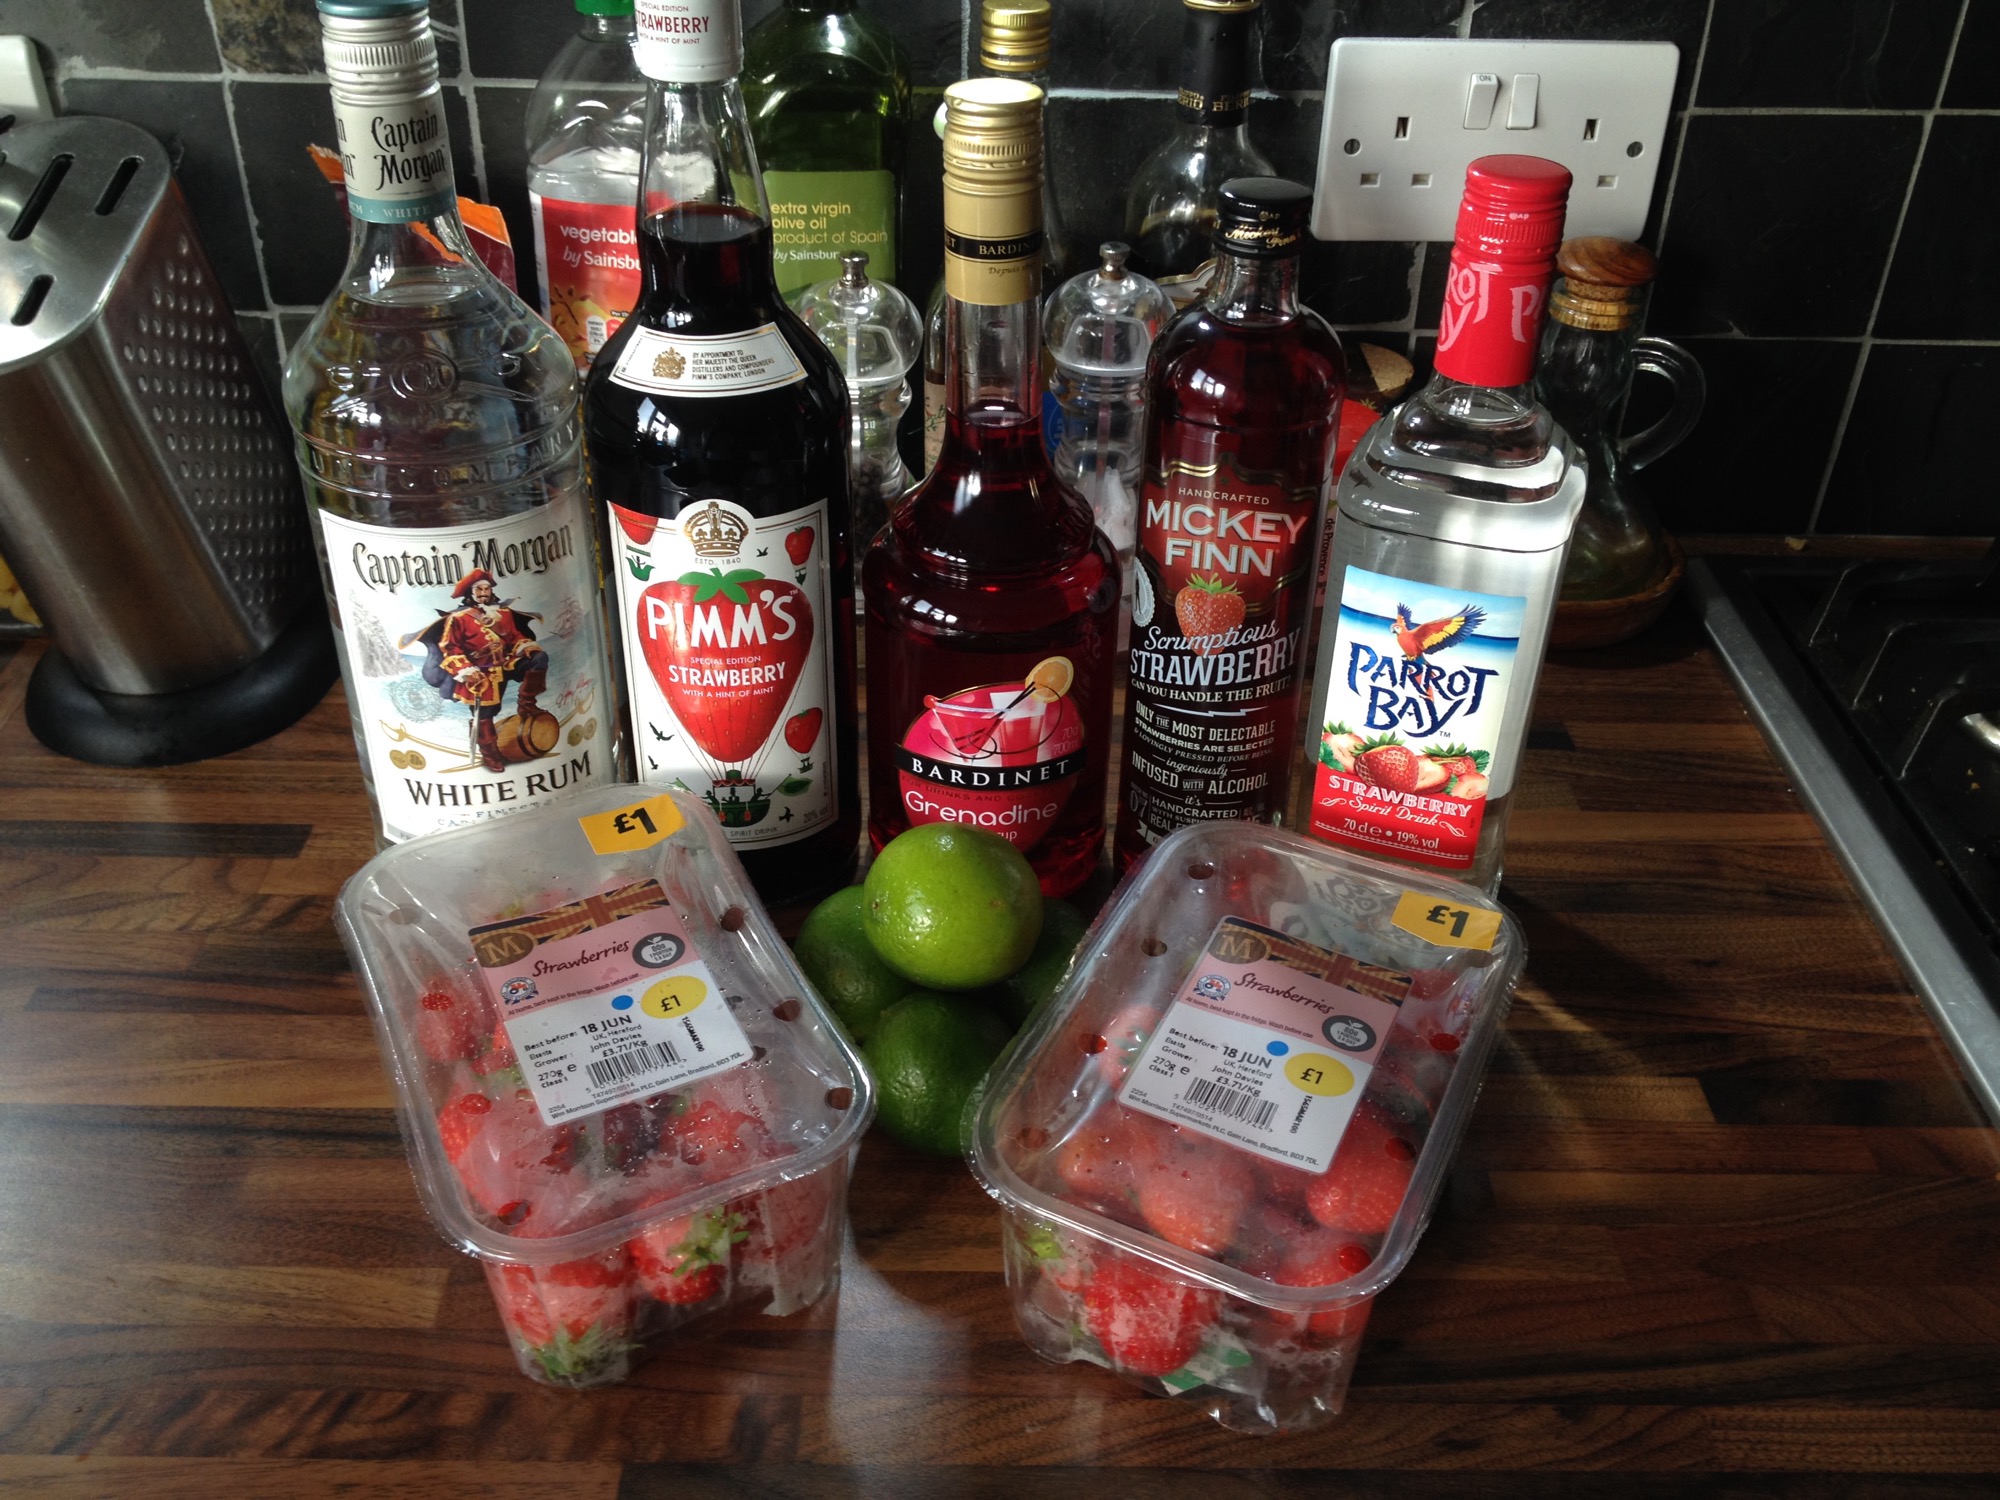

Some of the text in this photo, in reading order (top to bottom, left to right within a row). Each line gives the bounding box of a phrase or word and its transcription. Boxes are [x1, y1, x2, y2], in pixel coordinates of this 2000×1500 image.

[636, 10, 709, 33] TRAWBERRY
[661, 5, 689, 13] EDITION
[371, 110, 439, 153] Captain
[373, 147, 446, 191] Morgan
[383, 204, 432, 218] WHITE
[771, 202, 851, 217] extra virgin
[772, 217, 827, 229] olive oil
[774, 231, 888, 244] product of Spain
[563, 246, 642, 272] by Sainsbu
[774, 248, 788, 264] by
[692, 365, 723, 373] DISTILLERS
[737, 358, 775, 371] COMPOUNDERS
[740, 355, 757, 363] QUEEN
[744, 368, 766, 377] LONDON
[1178, 487, 1270, 505] HANDCRAFTED
[1146, 498, 1308, 545] MICKEY
[1325, 517, 1335, 531] de
[352, 522, 575, 593] Captain Morgan
[721, 557, 742, 565] 1840
[1165, 537, 1275, 578] FINN
[1319, 531, 1334, 577] Provence
[645, 589, 797, 650] PIMM'S
[1144, 619, 1281, 660] Scrumptious
[690, 655, 761, 665] SPECIAL EDITION
[1130, 627, 1302, 687] STRAWBERRY
[668, 661, 786, 687] STRAWBERRY
[1347, 641, 1500, 717] PARROT
[682, 686, 774, 698] WITH A HINT OF MINT
[1131, 678, 1146, 691] CAN
[1146, 684, 1168, 698] YOU
[1169, 689, 1223, 702] HANDLE
[1226, 688, 1254, 702] THE
[1135, 699, 1276, 742] ONLY THE MOST DELECTABLE
[1363, 684, 1467, 738] BAY
[1134, 716, 1276, 753] STRAWBERRIES ARE SELECTED
[1139, 731, 1174, 754] LOVINGLY
[1174, 749, 1216, 763] PRESSED
[1217, 752, 1251, 763] BEFORE
[404, 749, 593, 807] WHITE RUM
[911, 756, 1070, 787] BARDINET
[1132, 749, 1180, 789] INFUSED
[1182, 779, 1204, 791] WITH
[1206, 771, 1270, 796] ALCOHOL
[1165, 756, 1230, 780] ingeniously
[905, 789, 1059, 827] Grenadine
[1151, 796, 1239, 820] HANDCRAFTED
[1328, 774, 1473, 818] STRAWBERRY
[613, 807, 657, 834] £1
[1348, 795, 1440, 826] Spirit Drink
[730, 826, 779, 838] SPIRIT DRINK
[1343, 817, 1357, 831] 70
[1396, 831, 1420, 846] 19%
[1421, 837, 1441, 850] vol
[1426, 904, 1470, 938] £1
[481, 935, 526, 966] M
[531, 939, 631, 978] Strawberries
[1215, 934, 1256, 961] M
[660, 994, 682, 1012] £1
[1233, 972, 1336, 1016] Strawberries
[523, 1014, 633, 1053] Best before: 18 JUN
[592, 1024, 643, 1042] UK, Hereford
[533, 1033, 643, 1069] Grower John Davies
[602, 1040, 650, 1059] £3.71/Kg
[1168, 1027, 1274, 1070] Best before: 18 JUN
[537, 1068, 565, 1082] 270g
[1152, 1055, 1177, 1073] 270g
[1160, 1044, 1264, 1087] Grower John Davies
[1223, 1059, 1274, 1080] UK, Hereford
[1299, 1067, 1324, 1085] £1
[1215, 1075, 1263, 1099] £3.71/Kg
[1168, 1108, 1212, 1130] Supermarkets
